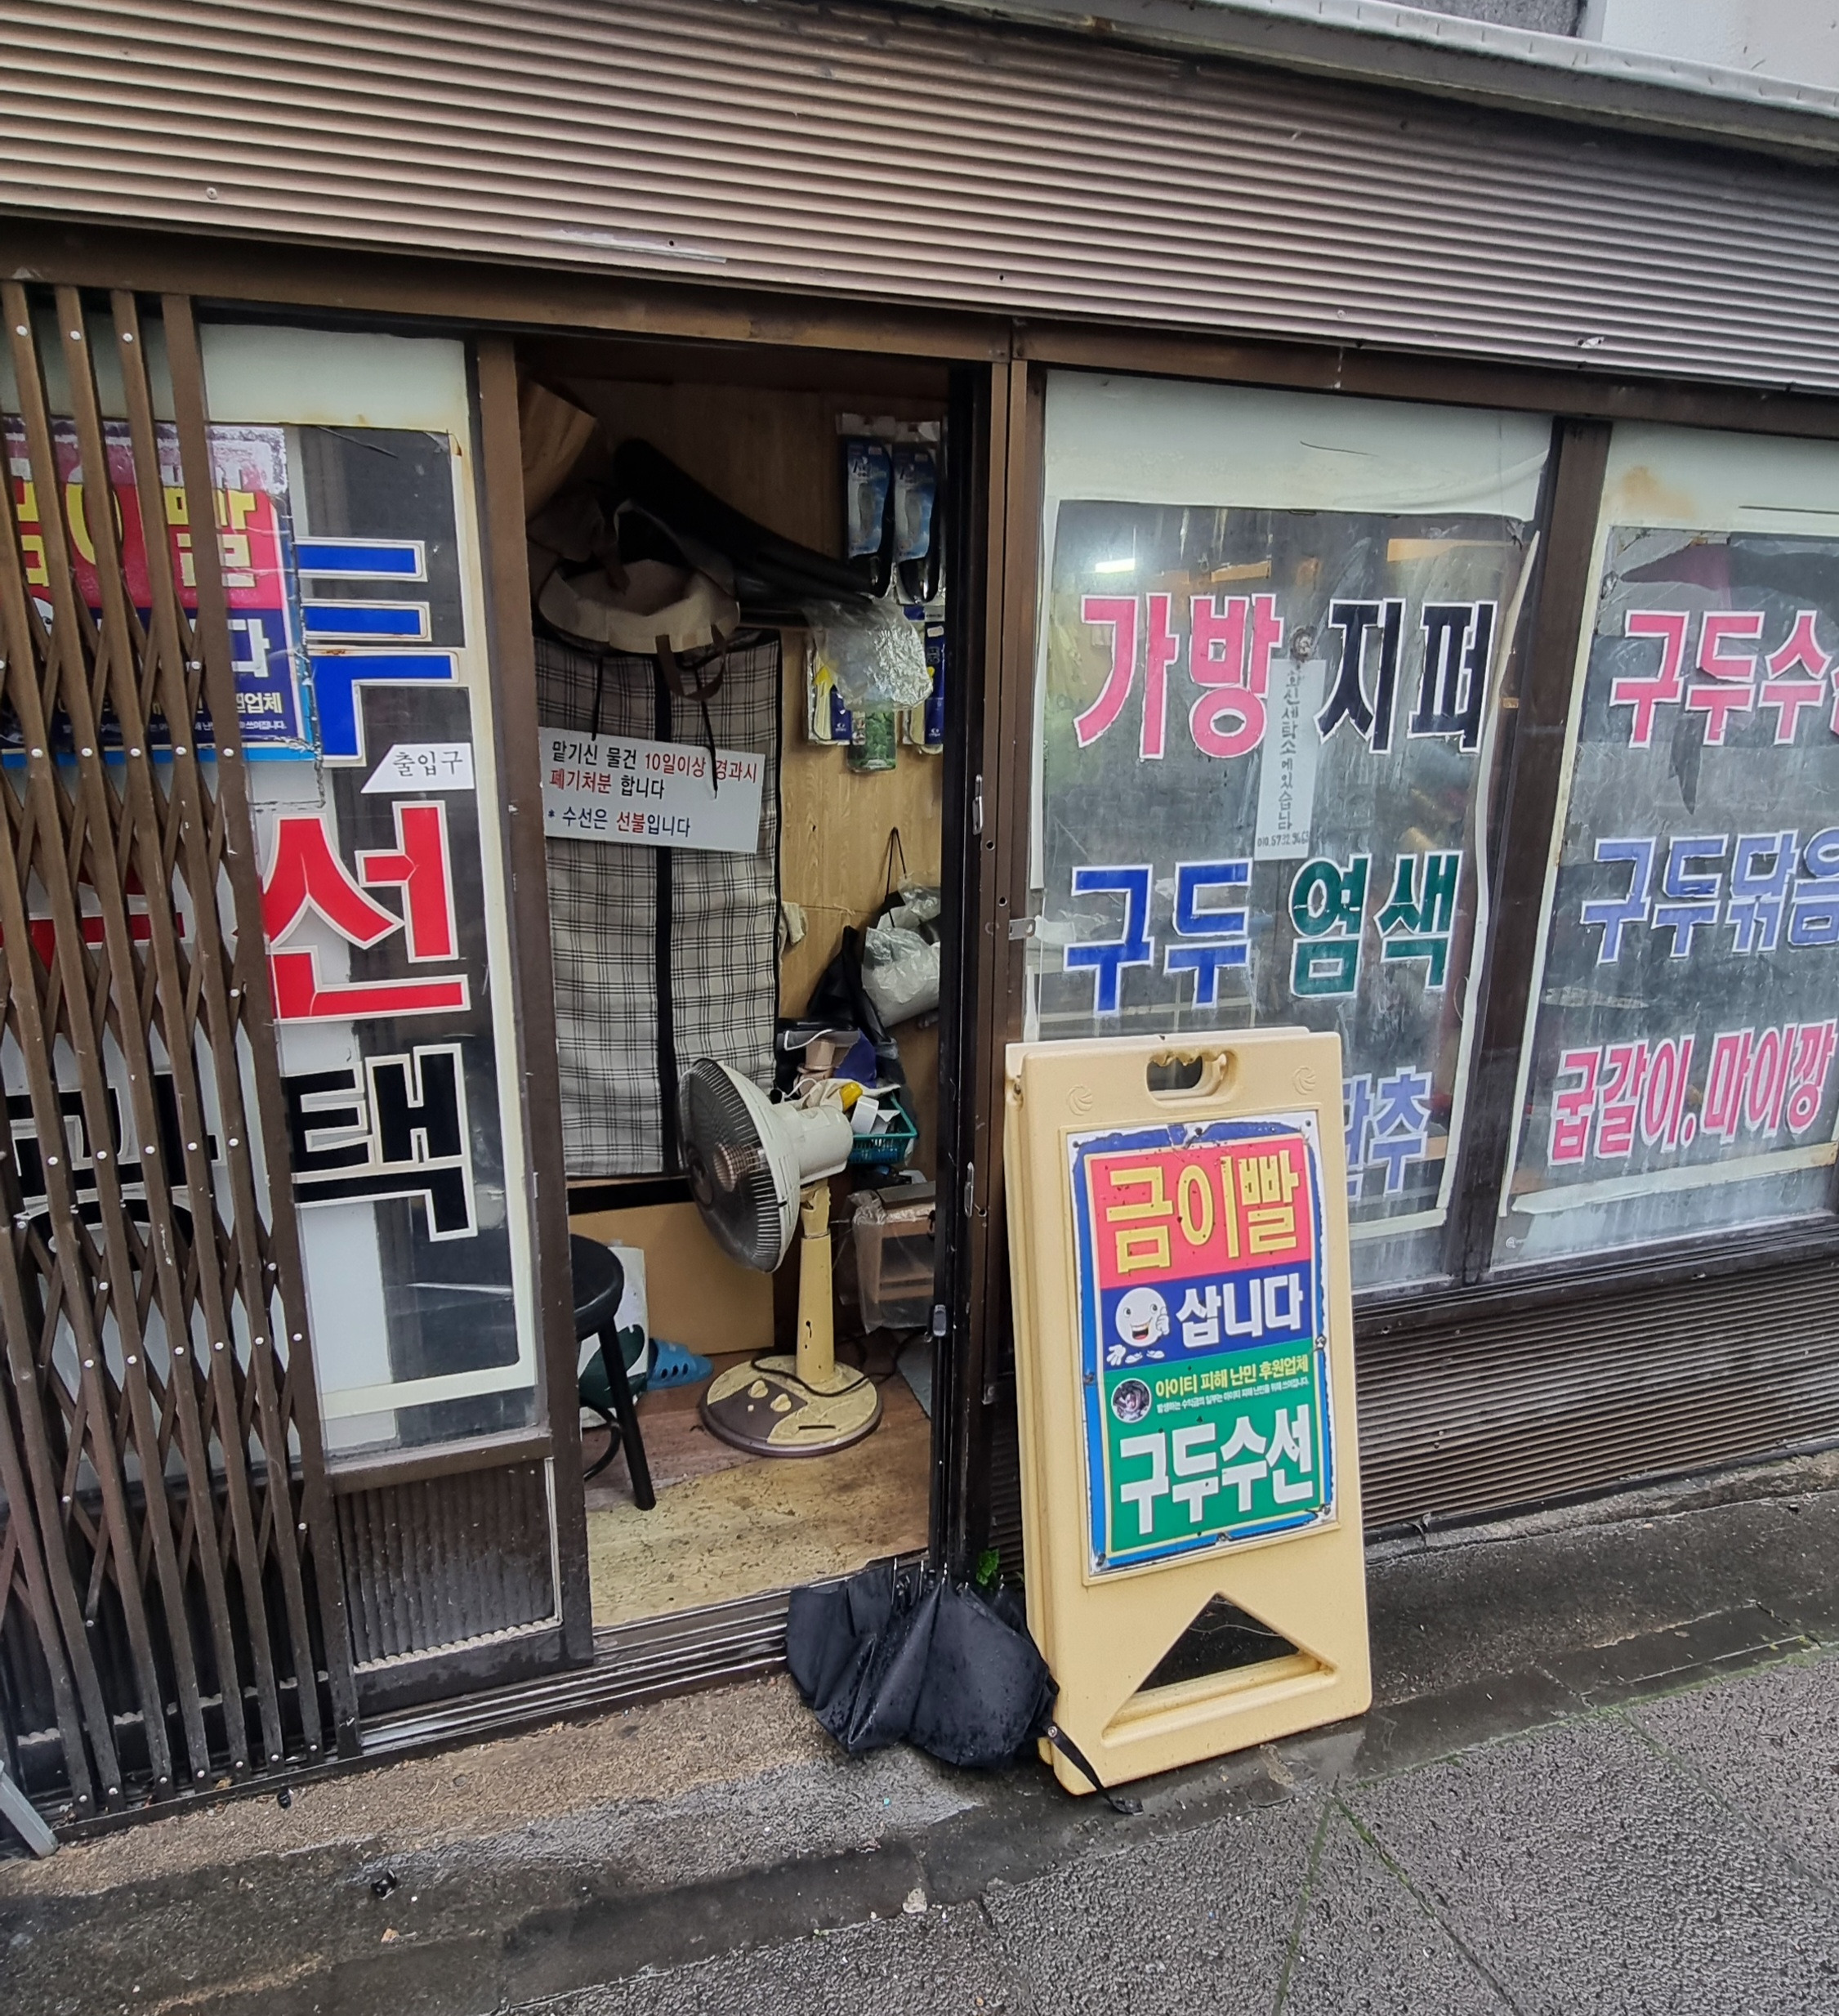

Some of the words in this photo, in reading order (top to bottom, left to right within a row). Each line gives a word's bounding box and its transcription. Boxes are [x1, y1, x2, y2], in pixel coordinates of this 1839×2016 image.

[1073, 592, 1284, 762] 가방
[1313, 597, 1498, 753] 지퍼
[1609, 610, 1839, 749] 구두수
[391, 746, 463, 777] 출입구
[550, 768, 612, 794] 폐기처분
[620, 775, 664, 800] 합니다
[552, 740, 597, 766] 맡기신
[606, 747, 636, 770] 물건
[645, 753, 706, 778] 10일이상
[715, 759, 757, 784] 경과시
[562, 806, 608, 830] 수선은
[616, 811, 691, 838] 선불입니다
[1063, 857, 1254, 1017] 구두
[1288, 851, 1463, 999] 염색
[1579, 825, 1839, 967] 구두닦음
[1106, 1149, 1301, 1273] 금이빨
[1176, 1272, 1303, 1348] 삽니다
[1155, 1374, 1198, 1398] 아이티
[1200, 1369, 1228, 1390] 피해
[1230, 1364, 1257, 1386] 난민
[1259, 1354, 1309, 1380] 후원업체
[1120, 1404, 1313, 1535] 구두수선
